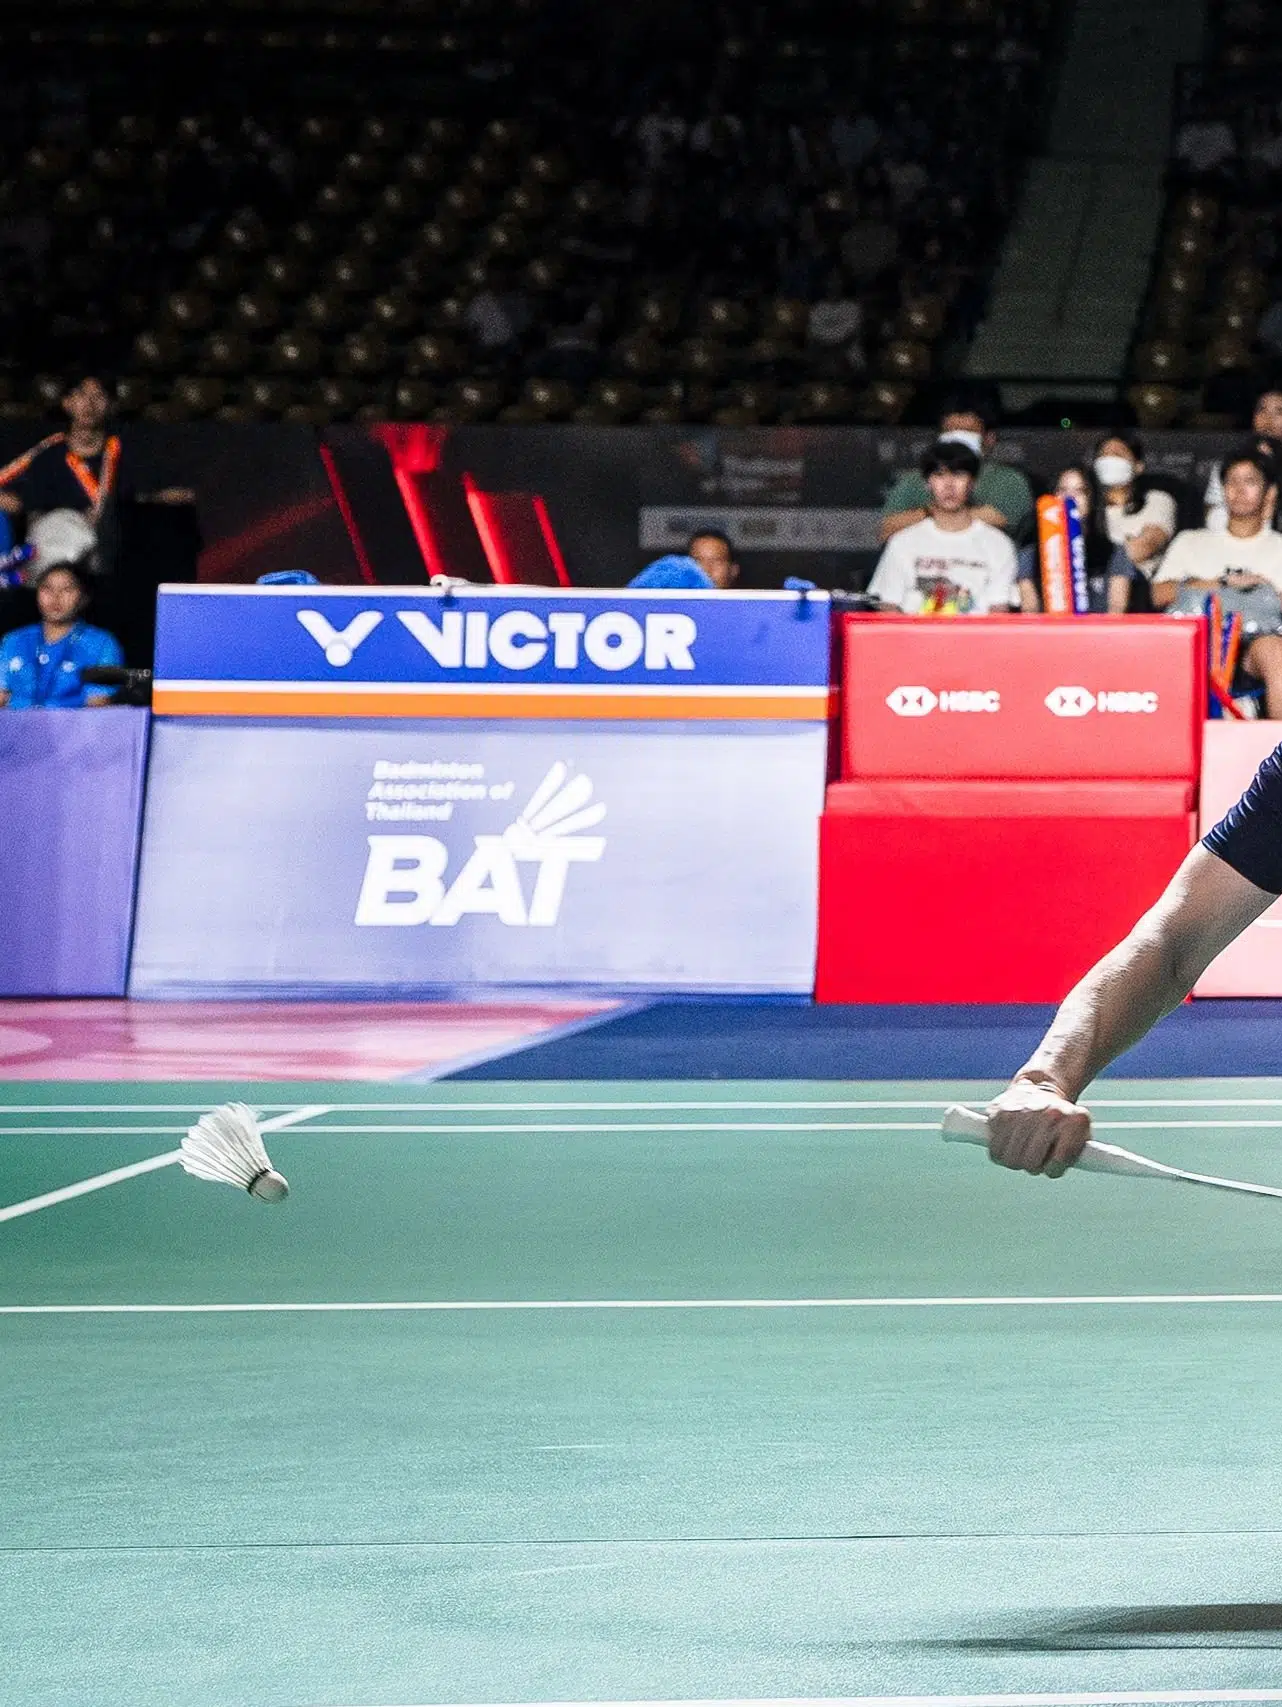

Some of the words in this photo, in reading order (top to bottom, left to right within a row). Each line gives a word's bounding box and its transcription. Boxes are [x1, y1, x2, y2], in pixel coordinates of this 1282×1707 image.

[395, 610, 698, 671] VICTOR
[938, 690, 1001, 713] HSBC
[1096, 690, 1159, 713] HSBC
[489, 781, 515, 800] of
[365, 801, 454, 821] Thailand
[354, 834, 607, 927] BAT
